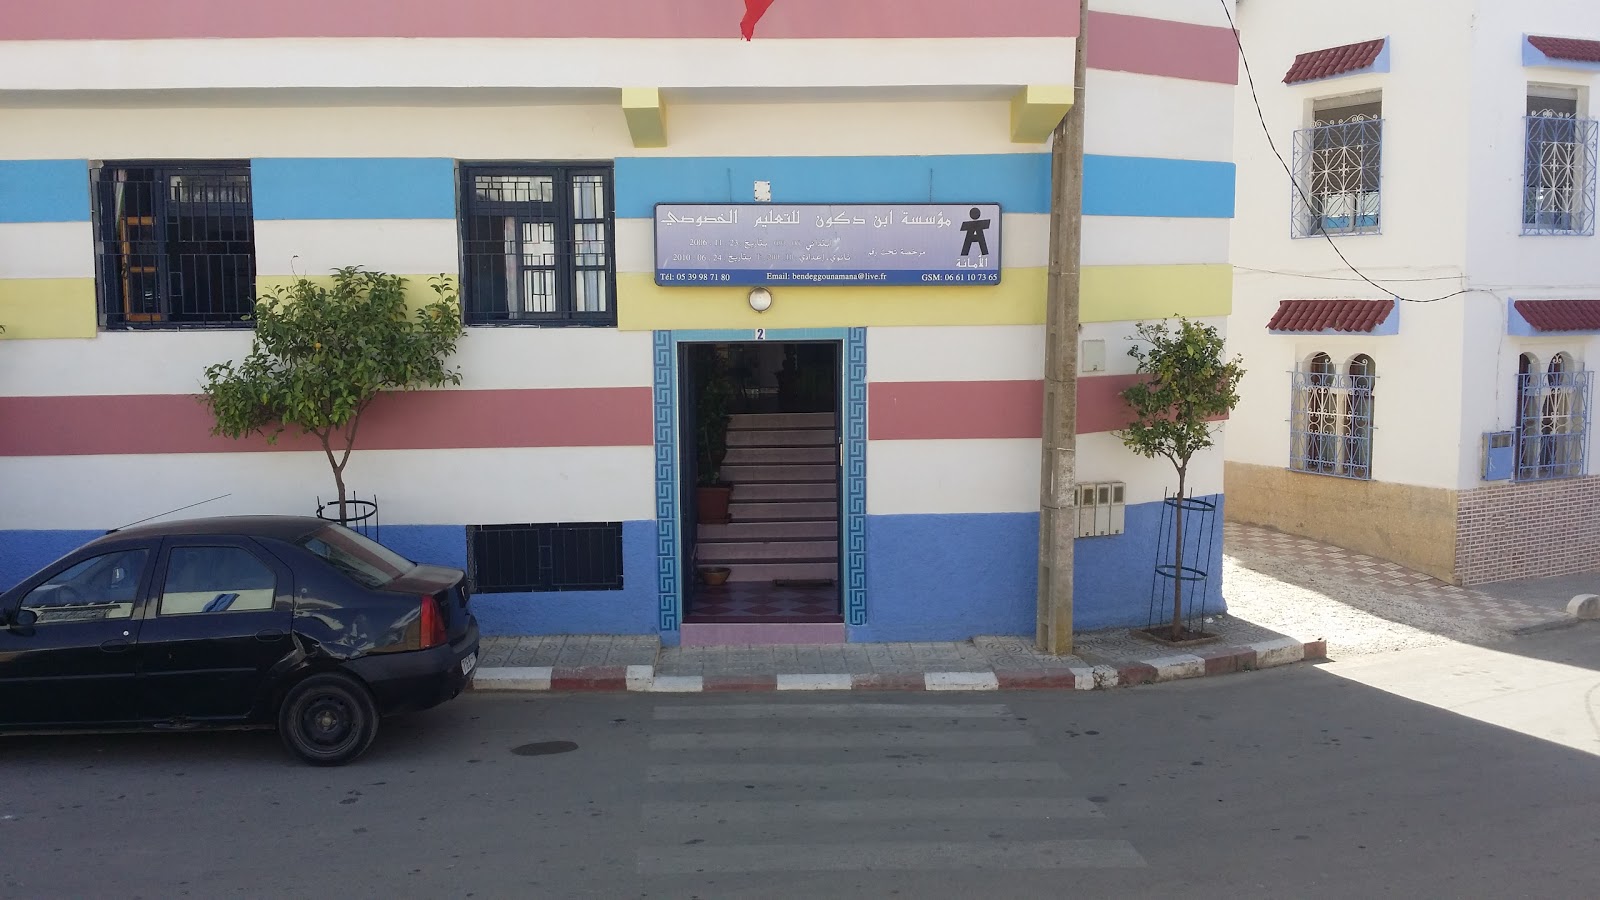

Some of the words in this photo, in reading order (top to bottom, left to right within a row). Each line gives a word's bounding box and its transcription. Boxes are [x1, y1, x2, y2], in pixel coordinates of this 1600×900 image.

[660, 208, 739, 227] الخصوصي
[753, 209, 800, 228] للتعليم
[815, 210, 866, 228] دكون
[873, 209, 893, 228] ابن
[901, 210, 952, 228] مؤسسة
[956, 255, 988, 269] الأمانة
[660, 272, 675, 281] Tél:
[676, 273, 686, 281] 05
[687, 273, 697, 281] 39
[698, 273, 708, 281] 98
[709, 273, 718, 281] 71
[720, 273, 730, 281] 80
[766, 272, 790, 280] Email:
[792, 272, 887, 282] bendeggounamana@live.fr
[921, 273, 943, 282] GSM:
[944, 273, 954, 281] 06
[955, 273, 964, 281] 61
[967, 273, 976, 281] 10
[977, 273, 987, 281] 73
[988, 273, 998, 281] 65
[757, 328, 764, 340] 2
